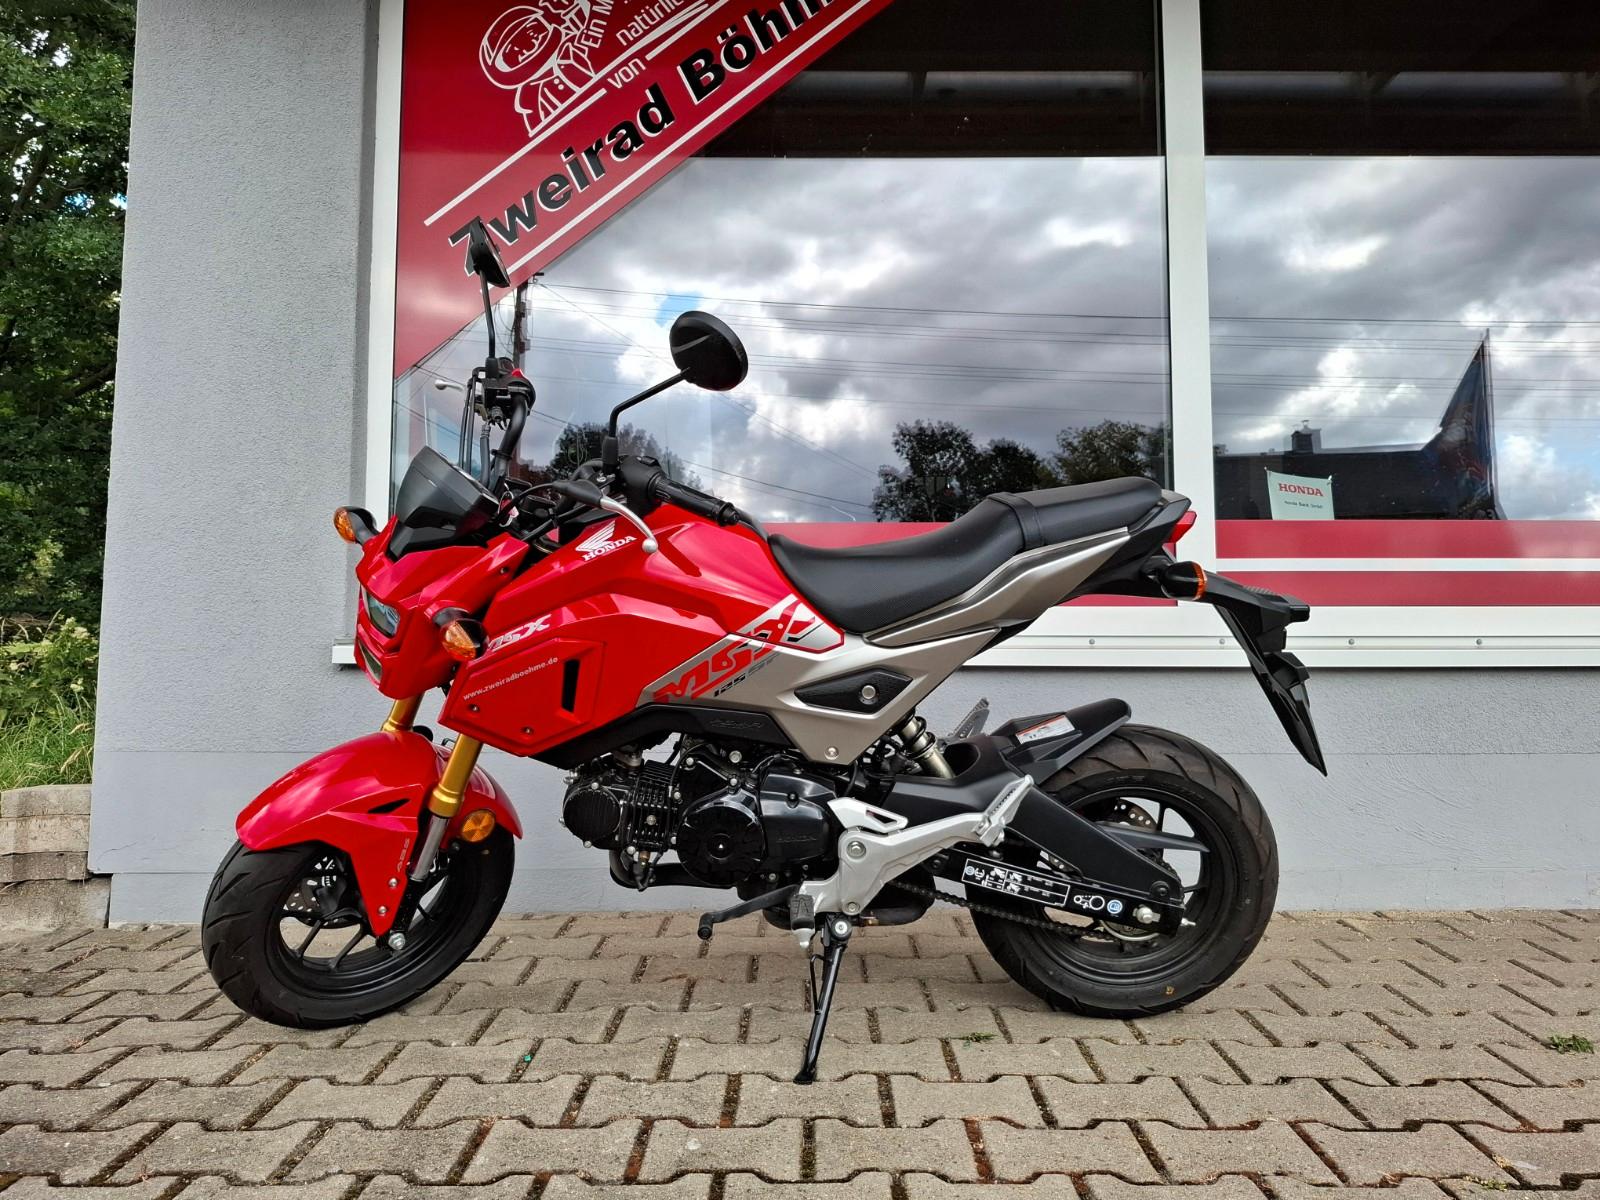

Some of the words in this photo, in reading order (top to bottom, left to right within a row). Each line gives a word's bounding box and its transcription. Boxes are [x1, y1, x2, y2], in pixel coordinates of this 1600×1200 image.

[580, 19, 607, 48] Ein
[606, 57, 647, 89] von
[1278, 482, 1324, 497] HONDA
[581, 535, 638, 561] HONDA
[463, 657, 559, 700] www.zweiradboehme.de
